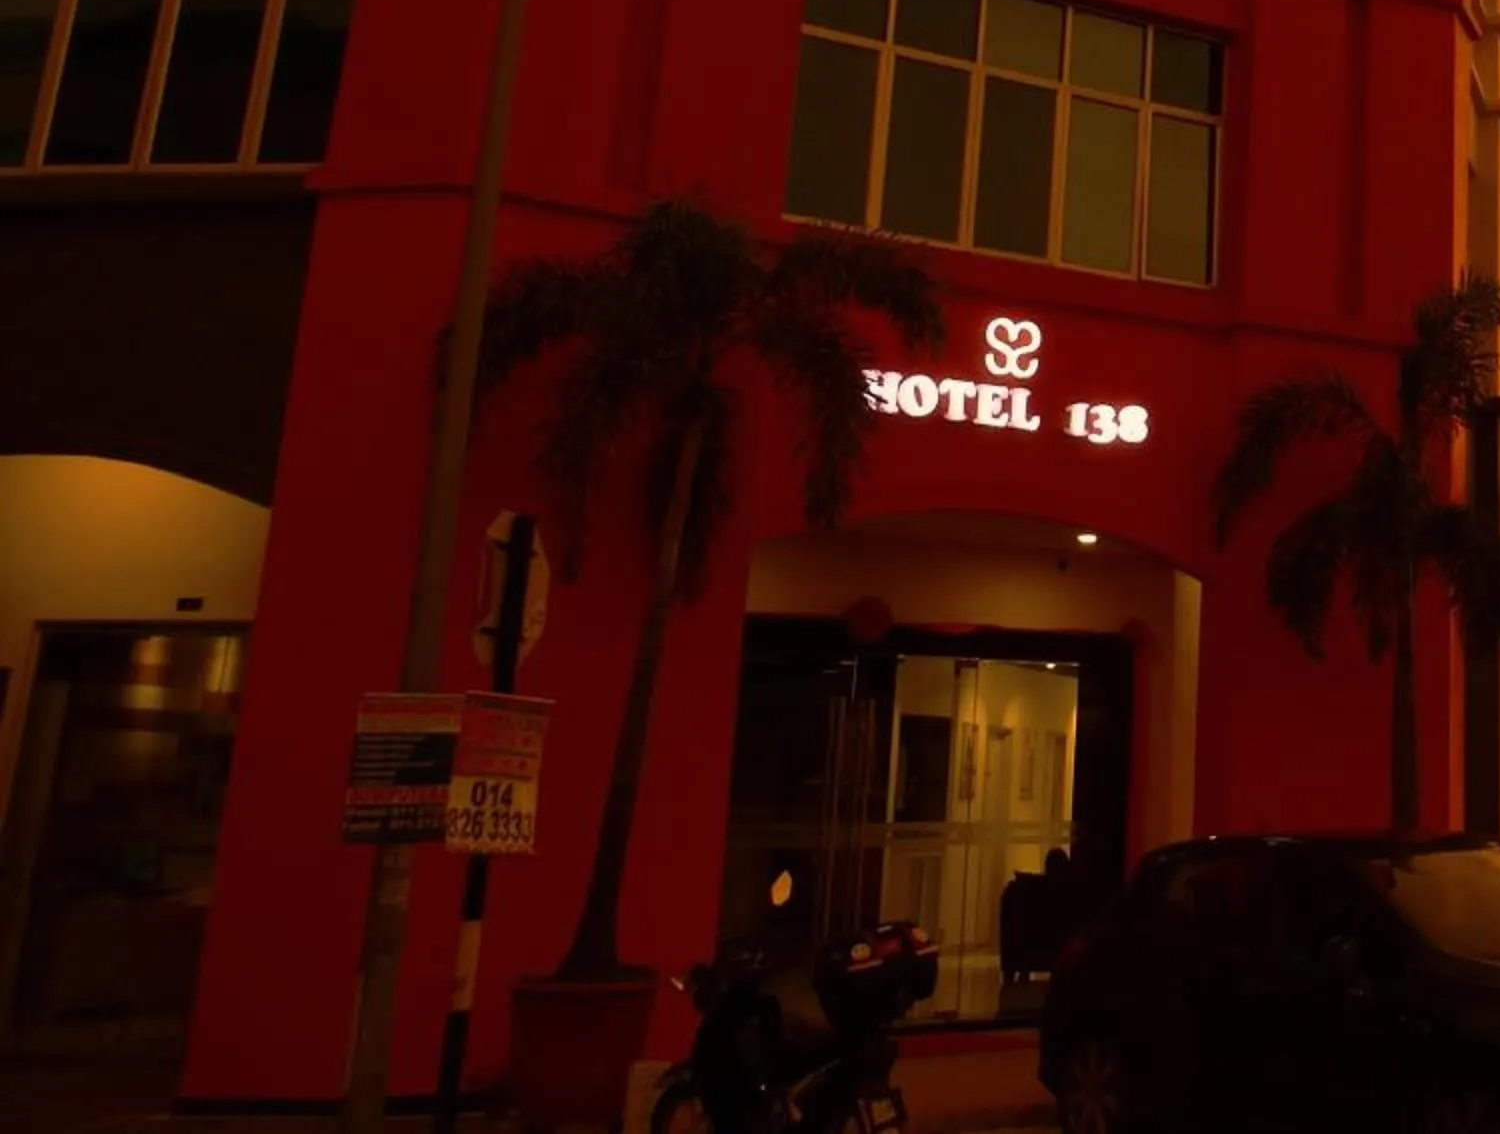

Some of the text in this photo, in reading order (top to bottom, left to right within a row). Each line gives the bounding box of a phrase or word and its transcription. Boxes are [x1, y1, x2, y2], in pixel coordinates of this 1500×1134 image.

[861, 369, 1149, 444] HOTEL 138
[471, 781, 513, 807] 014
[448, 808, 484, 840] 826
